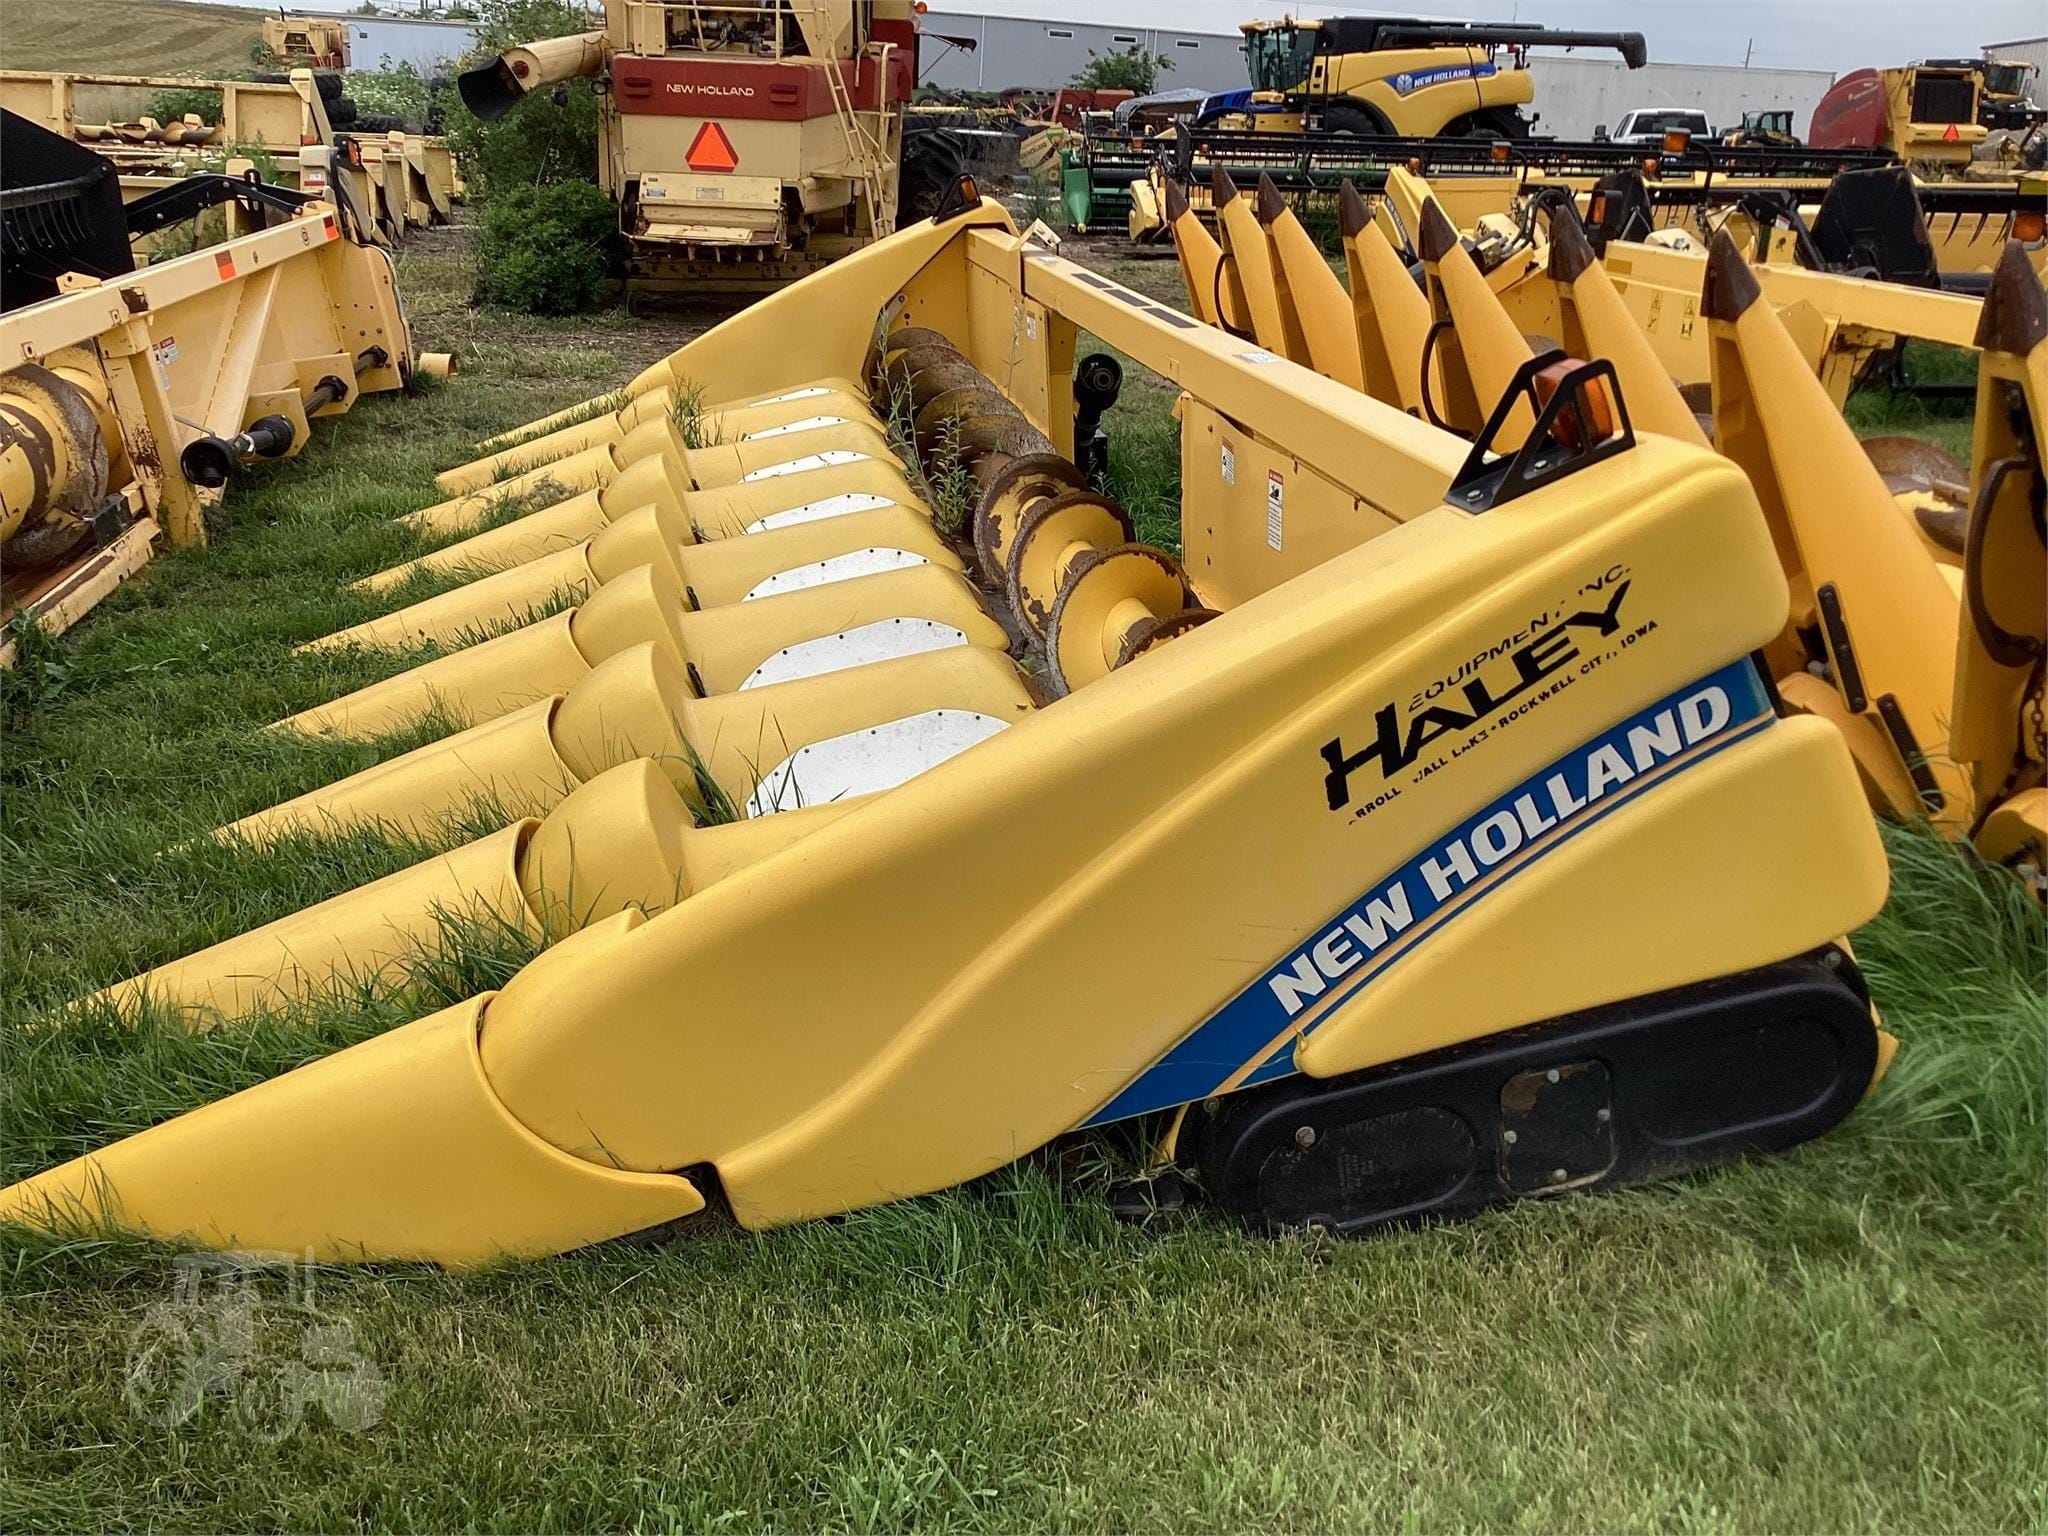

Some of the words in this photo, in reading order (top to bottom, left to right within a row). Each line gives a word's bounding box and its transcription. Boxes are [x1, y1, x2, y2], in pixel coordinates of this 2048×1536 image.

[666, 83, 694, 93] NEW
[697, 85, 755, 97] HOLLAND
[1414, 75, 1433, 88] NEW
[1433, 69, 1471, 82] HOLLAND
[1320, 579, 1631, 812] HALEY
[1408, 600, 1566, 713] EQUIPMEN
[1498, 675, 1576, 728] ROCKWELL
[1620, 620, 1658, 649] IOWA
[1268, 881, 1415, 1017] NEW
[1420, 686, 1731, 902] HOLLAND
